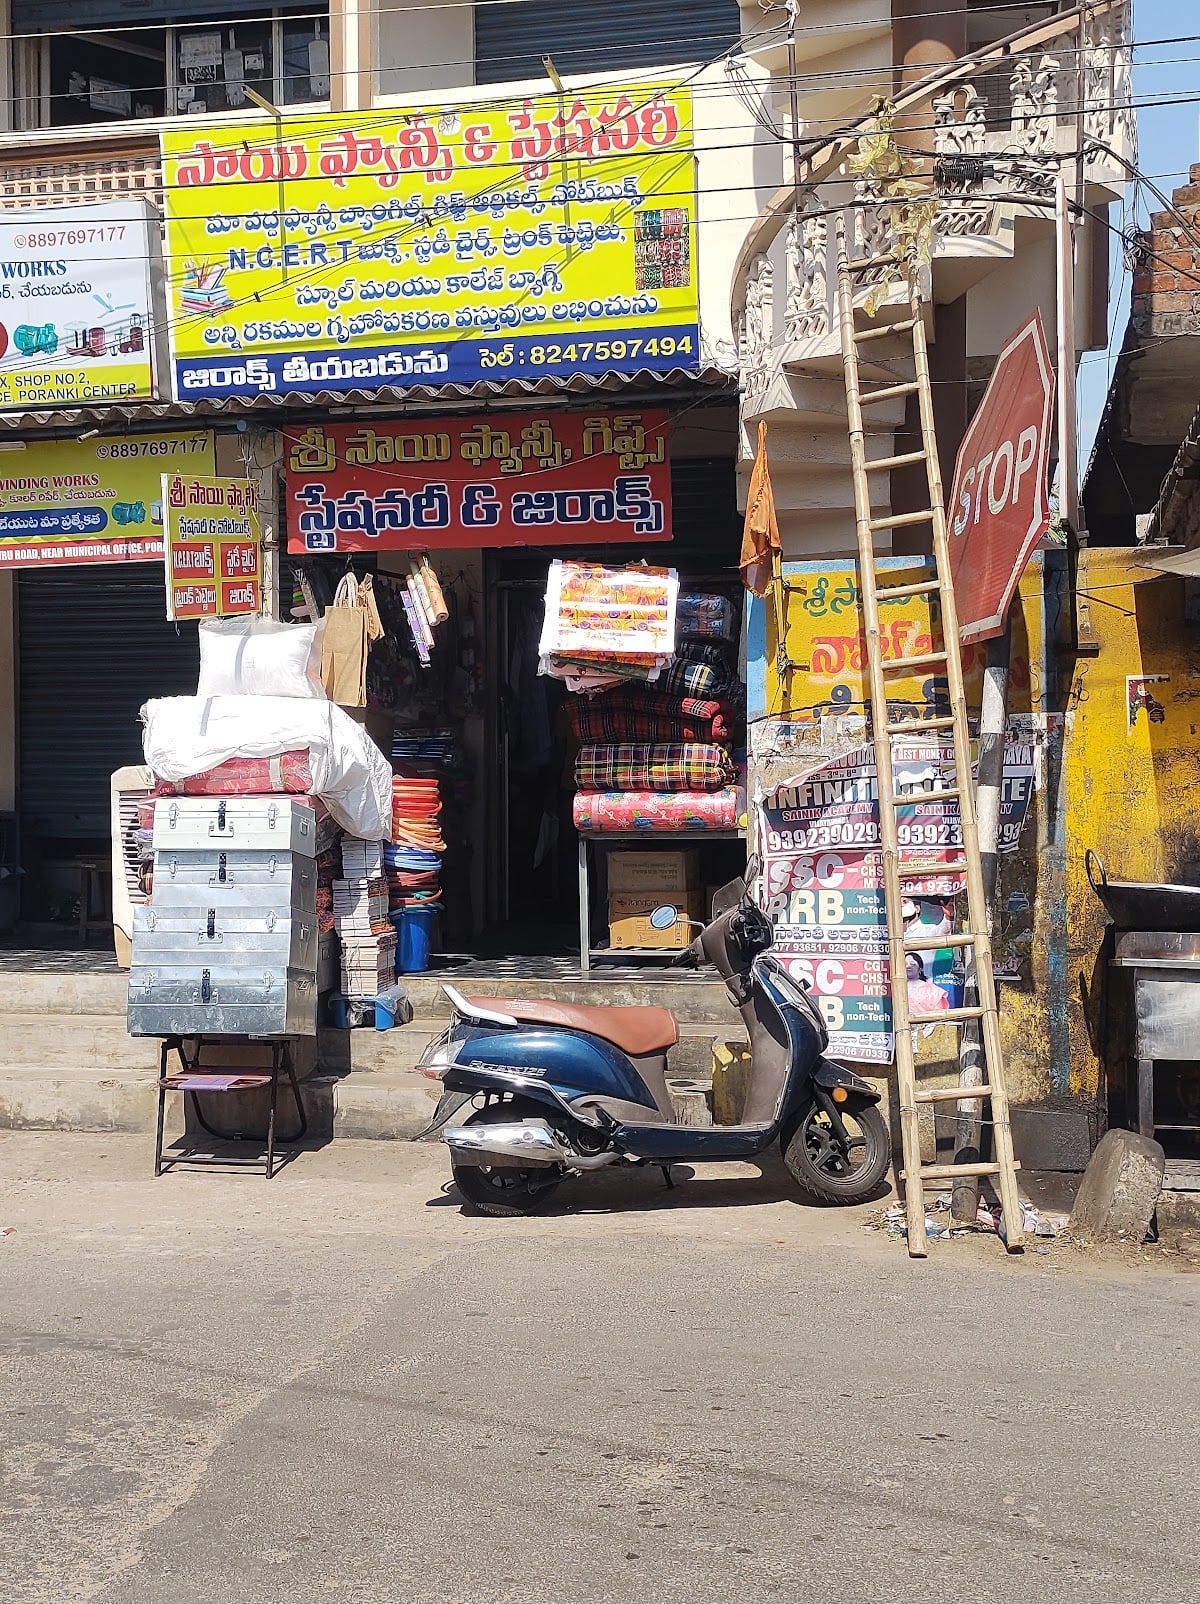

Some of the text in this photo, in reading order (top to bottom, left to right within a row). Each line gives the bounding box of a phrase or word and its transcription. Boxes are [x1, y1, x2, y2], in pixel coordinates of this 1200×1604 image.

[464, 126, 497, 162] &
[207, 214, 239, 233] మా
[28, 226, 126, 248] 8897697177
[1, 259, 67, 279] WORKS
[18, 281, 92, 299] చేయబడును
[359, 276, 440, 300] మరియు
[446, 266, 504, 293] కాలేజ్
[204, 324, 243, 350] అన్ని
[244, 320, 321, 342] రకముల
[552, 294, 658, 322] లభించును
[530, 336, 692, 365] 8247597494
[15, 374, 51, 387] SHOP
[19, 387, 79, 401] PORANKI
[83, 383, 137, 397] CENTER
[110, 439, 208, 458] 8897697177
[289, 427, 336, 473] శ్రీ
[345, 429, 451, 465] సాయి
[52, 473, 99, 488] WORKS
[955, 425, 1037, 536] STOP
[460, 484, 501, 528] &
[40, 516, 60, 529] మా
[42, 547, 63, 559] NEAR
[65, 544, 112, 557] MUNICIPAL
[782, 807, 821, 821] SAINIK
[767, 889, 844, 924] RRB
[857, 895, 880, 904] Tech
[829, 943, 858, 952] 92906
[864, 961, 887, 971] CGL
[861, 973, 891, 983] CHSL
[864, 985, 887, 996] MTS
[856, 1002, 880, 1011] Tech
[847, 1013, 890, 1022] non-Tech
